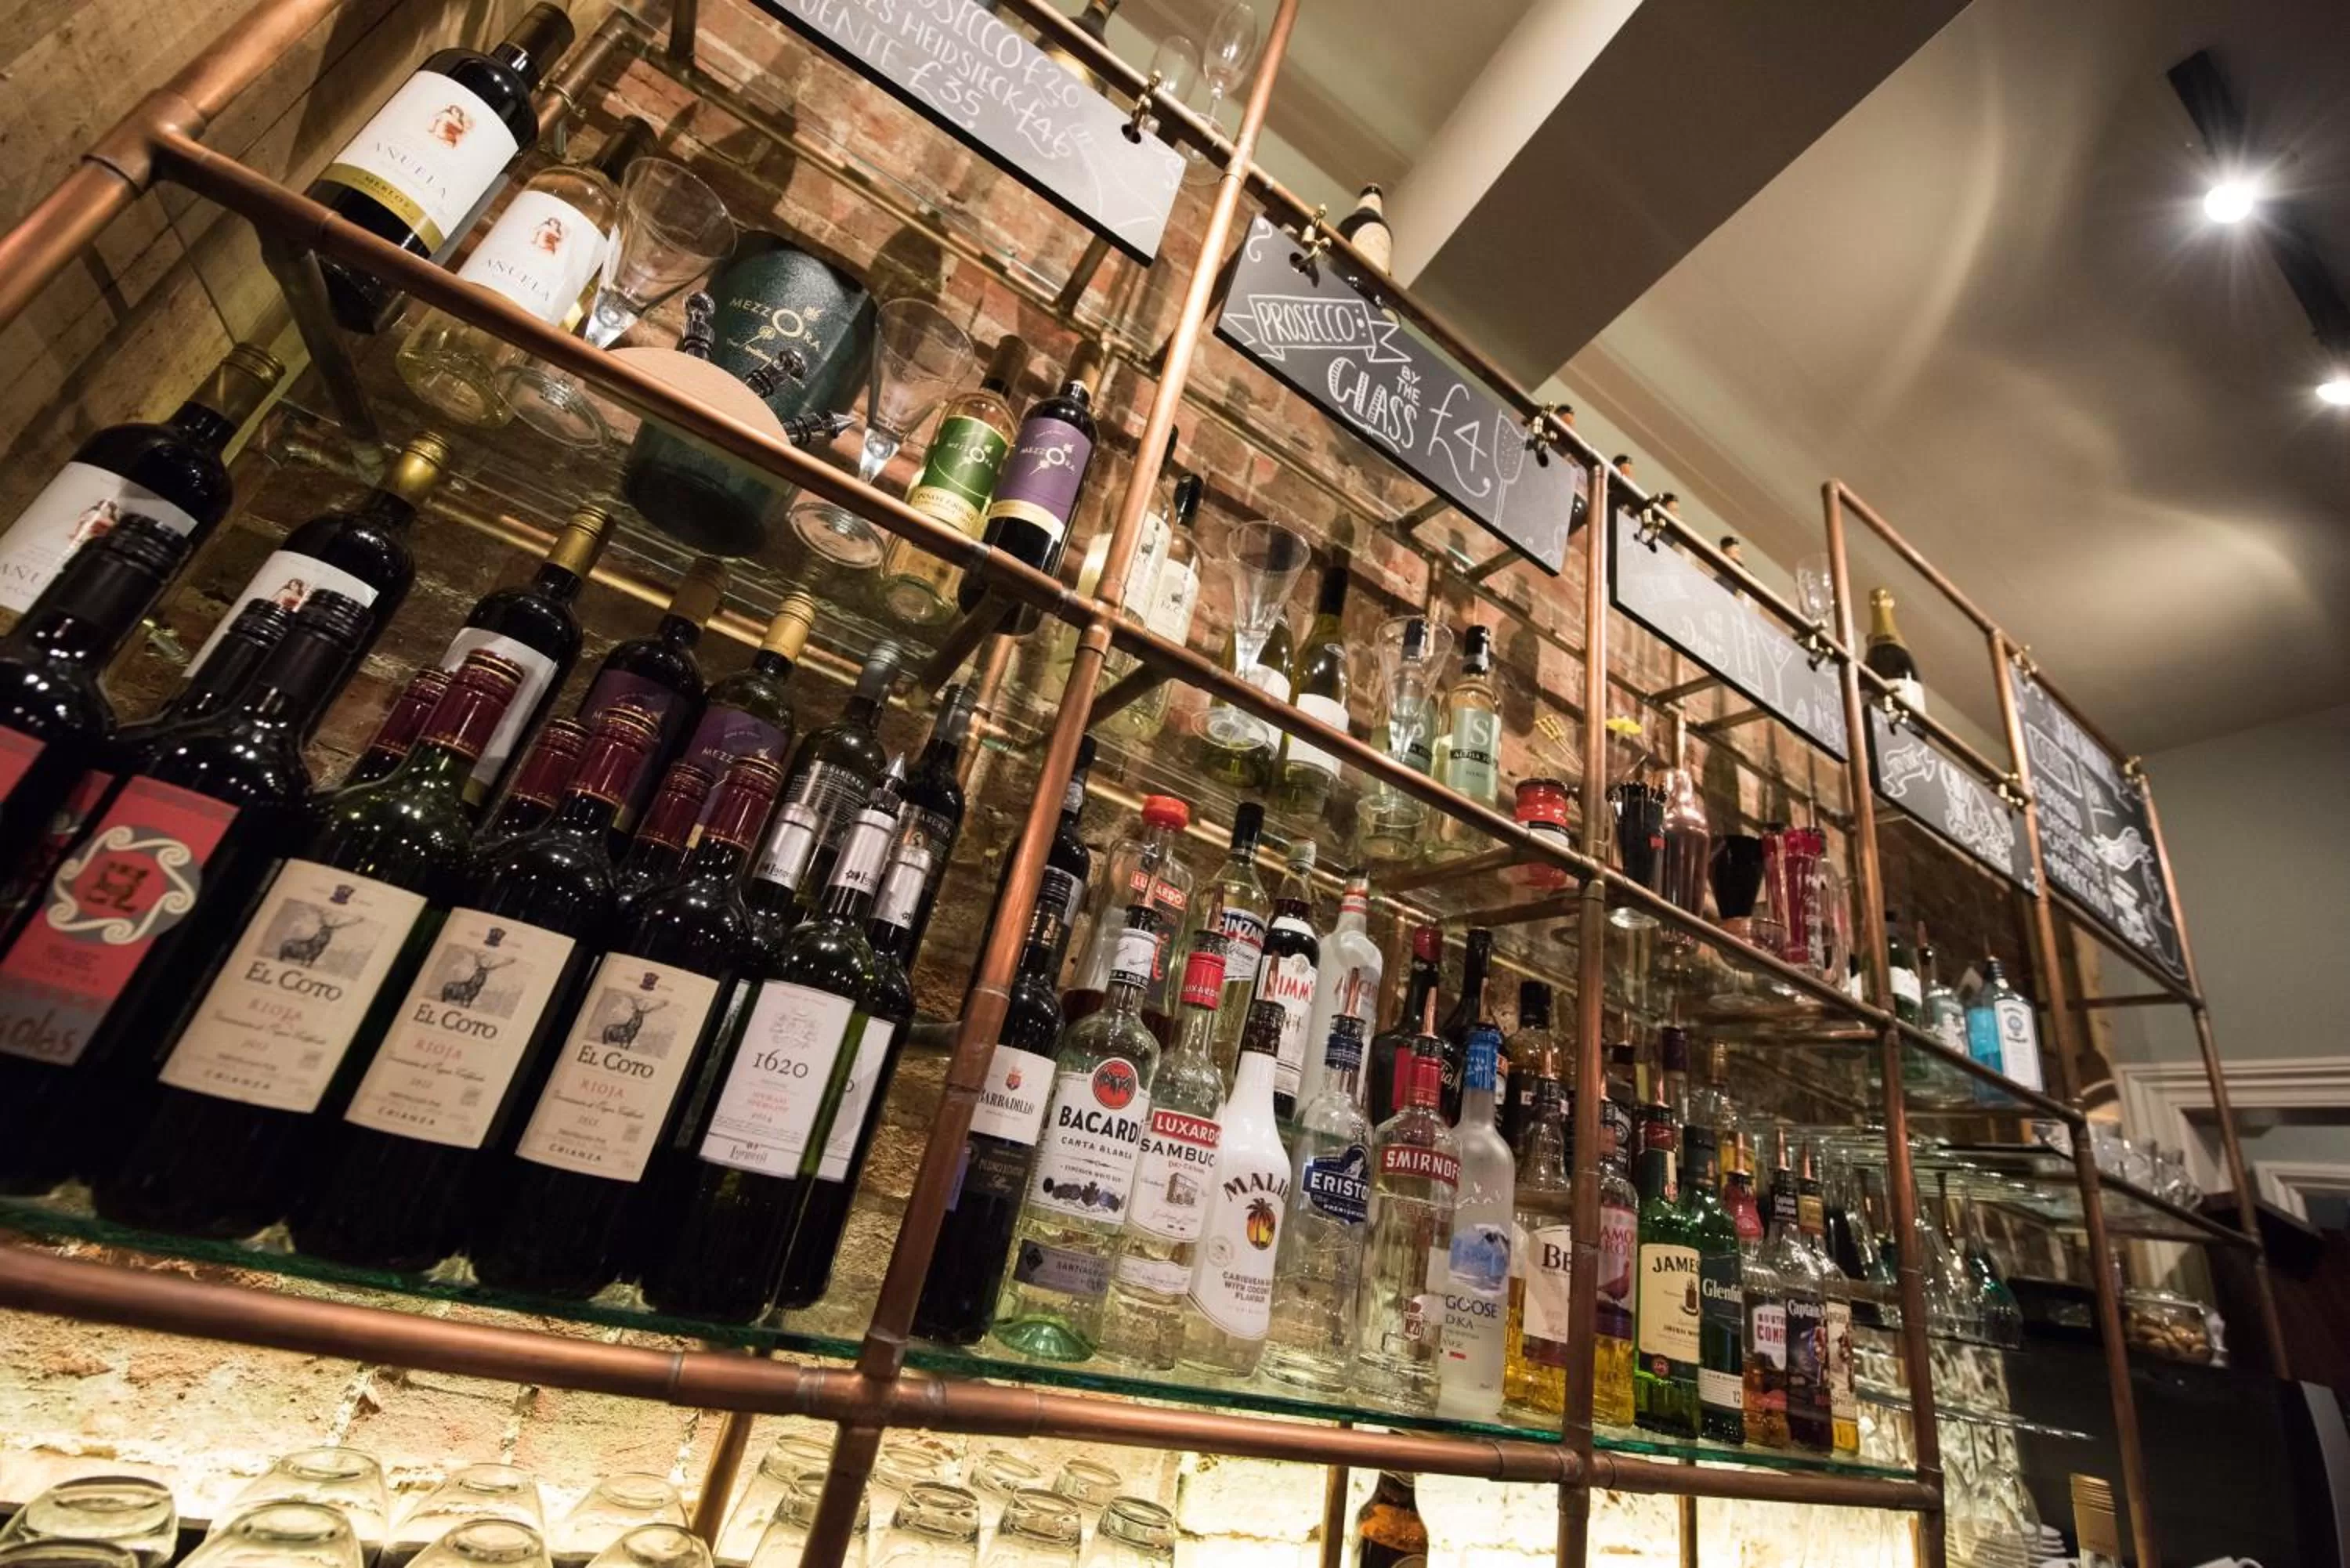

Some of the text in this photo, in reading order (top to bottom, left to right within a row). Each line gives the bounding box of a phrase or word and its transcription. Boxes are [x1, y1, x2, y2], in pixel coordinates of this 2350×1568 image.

[1397, 378, 1422, 409] THE
[1134, 874, 1184, 905] LUARDO
[244, 960, 343, 1002] EL COTO
[1183, 985, 1217, 998] UXARD
[1277, 975, 1315, 1002] IMM'
[413, 1003, 498, 1039] EL COTO
[414, 1038, 463, 1059] RIOJA
[576, 1044, 655, 1079] EL COTO
[752, 1050, 808, 1078] 1620
[580, 1078, 625, 1098] RIOJA
[1140, 1137, 1216, 1168] SAMBUC
[1223, 1172, 1289, 1203] MALI
[1310, 1171, 1368, 1201] ERISTO
[1651, 1255, 1701, 1275] JAME
[1702, 1277, 1743, 1304] Glenfi
[1444, 1295, 1499, 1319] GOOSE
[1444, 1313, 1474, 1330] DKA
[1756, 1324, 1785, 1346] COMF
[1732, 1390, 1741, 1405] 12
